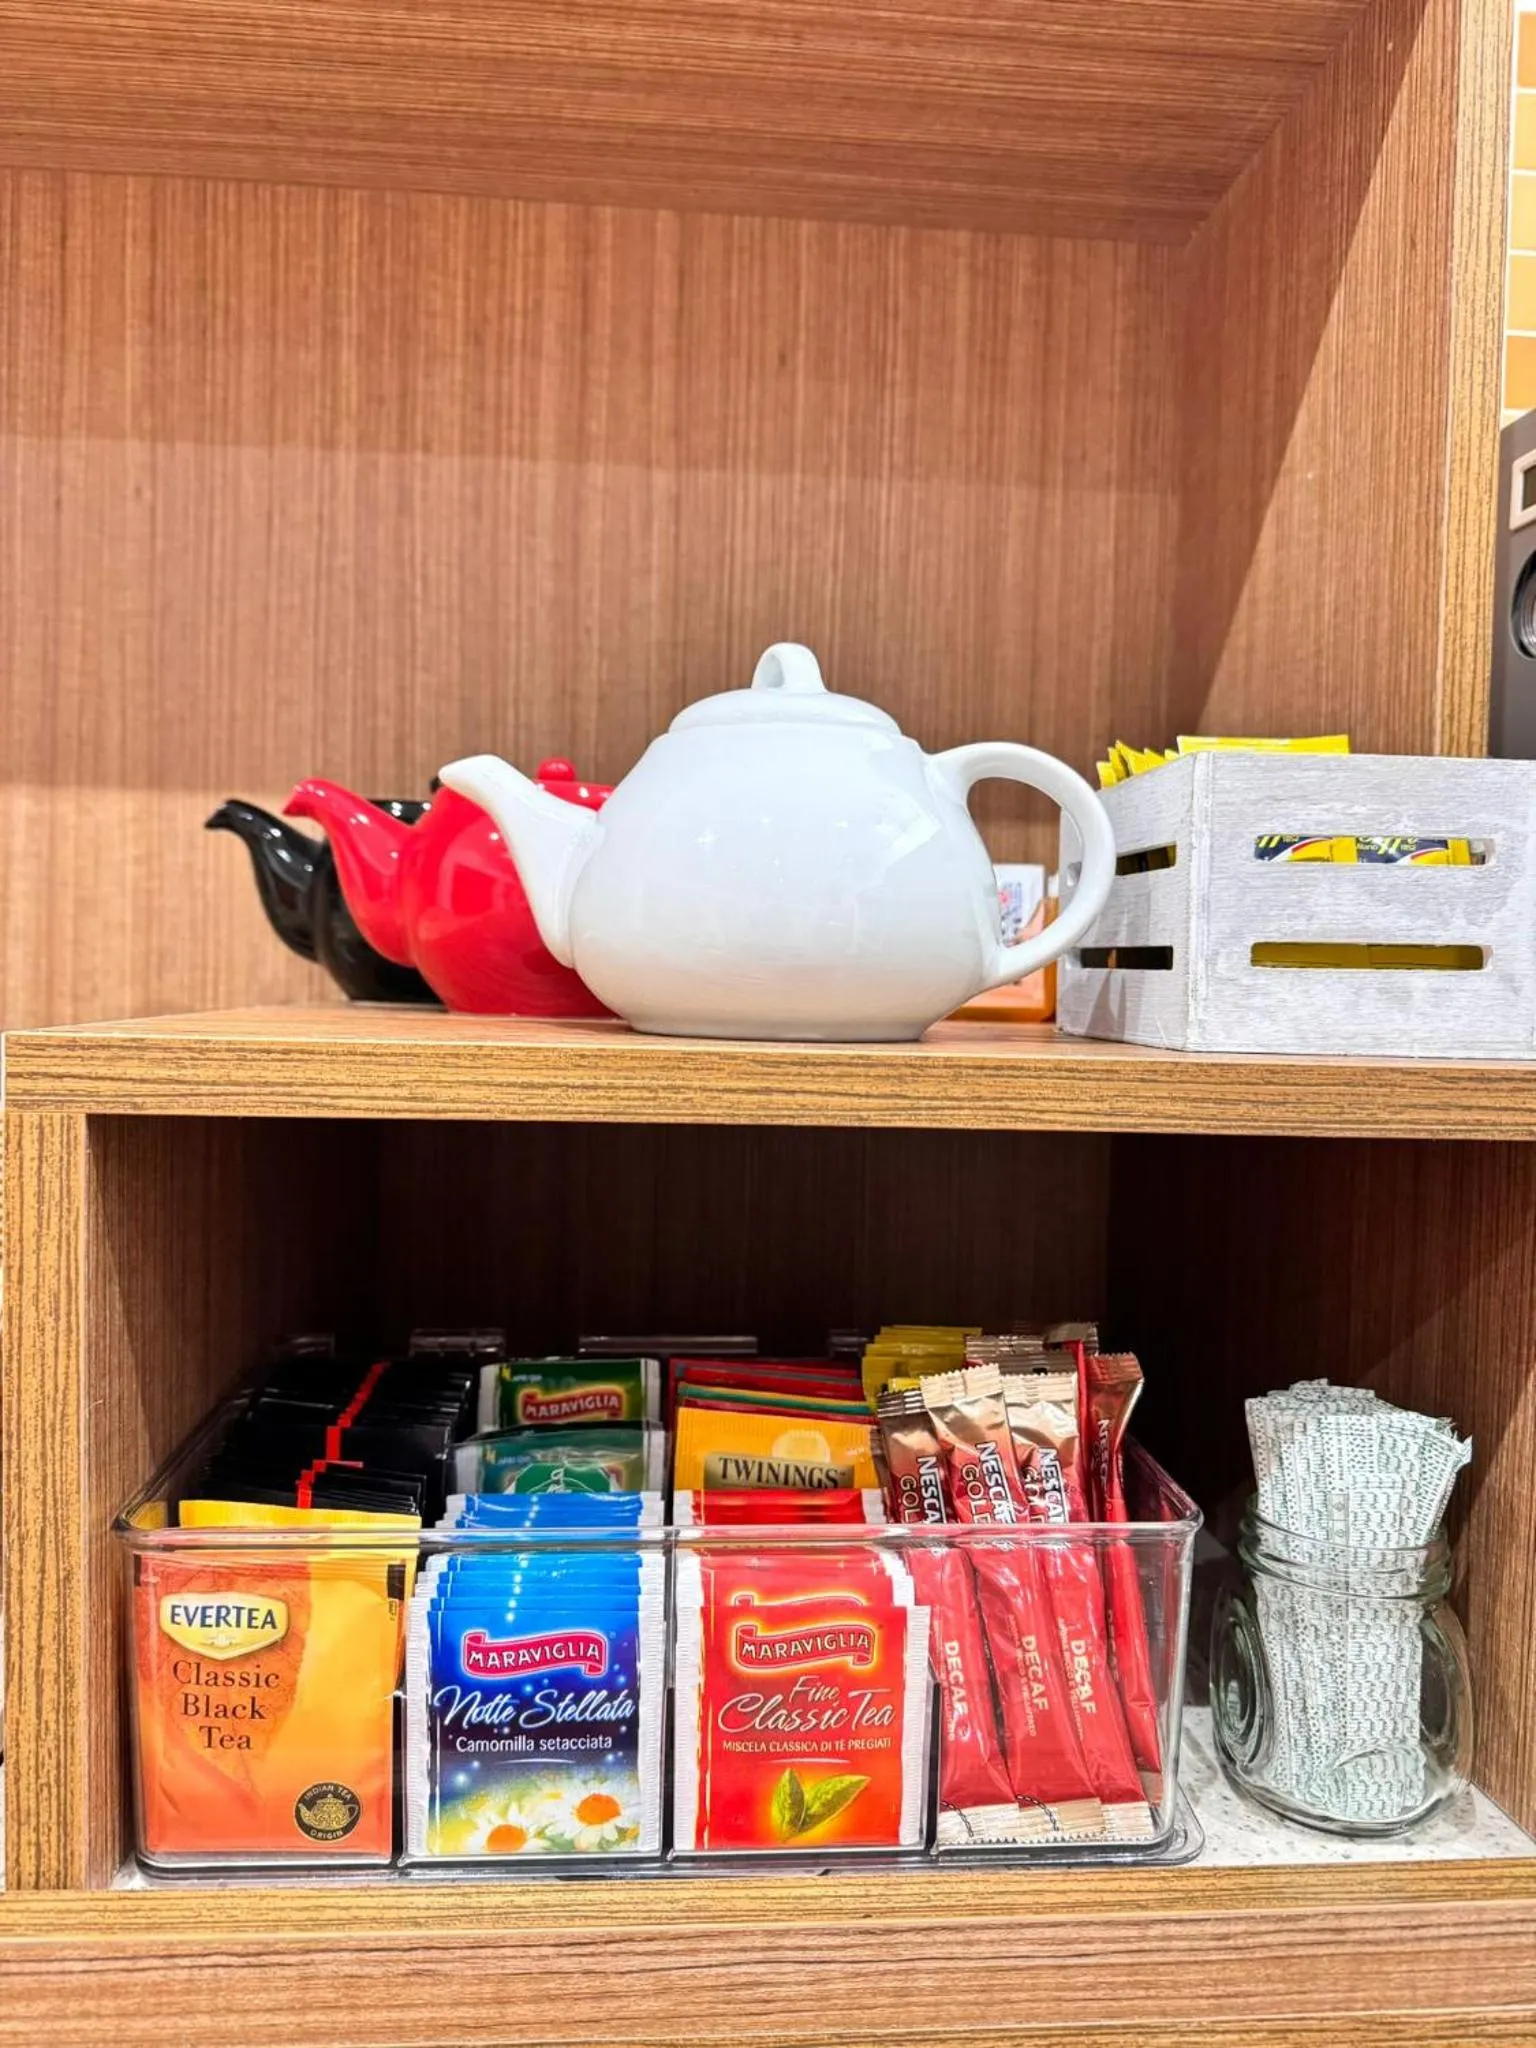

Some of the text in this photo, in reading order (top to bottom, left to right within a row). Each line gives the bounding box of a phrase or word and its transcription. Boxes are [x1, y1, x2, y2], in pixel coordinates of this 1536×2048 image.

[525, 1395, 620, 1417] MARAVIGLIA
[719, 1457, 839, 1489] TWININGS
[975, 1441, 1013, 1523] NESCAF
[900, 1475, 920, 1522] GOL
[917, 1456, 942, 1523] NESCA
[170, 1605, 277, 1630] EVERTEA
[468, 1642, 600, 1668] MARAVIGLIA
[741, 1633, 871, 1660] MARAVIGLIA
[173, 1660, 280, 1689] Classic
[944, 1640, 969, 1716] DECAF
[1021, 1635, 1049, 1710] DECAF
[1071, 1640, 1097, 1714] DECAF
[789, 1675, 840, 1703] Fine
[182, 1693, 267, 1720] Black
[434, 1685, 636, 1729] Notte Stellata
[718, 1688, 896, 1733] Classic Tea
[199, 1726, 252, 1750] Tea
[456, 1735, 612, 1752] Camomilla setacciata
[722, 1739, 767, 1752] MISCELA
[769, 1740, 819, 1752] CLASSICA
[820, 1740, 832, 1751] DI
[848, 1737, 891, 1750] PREGIATI
[304, 1785, 352, 1800] INDIAN TEA
